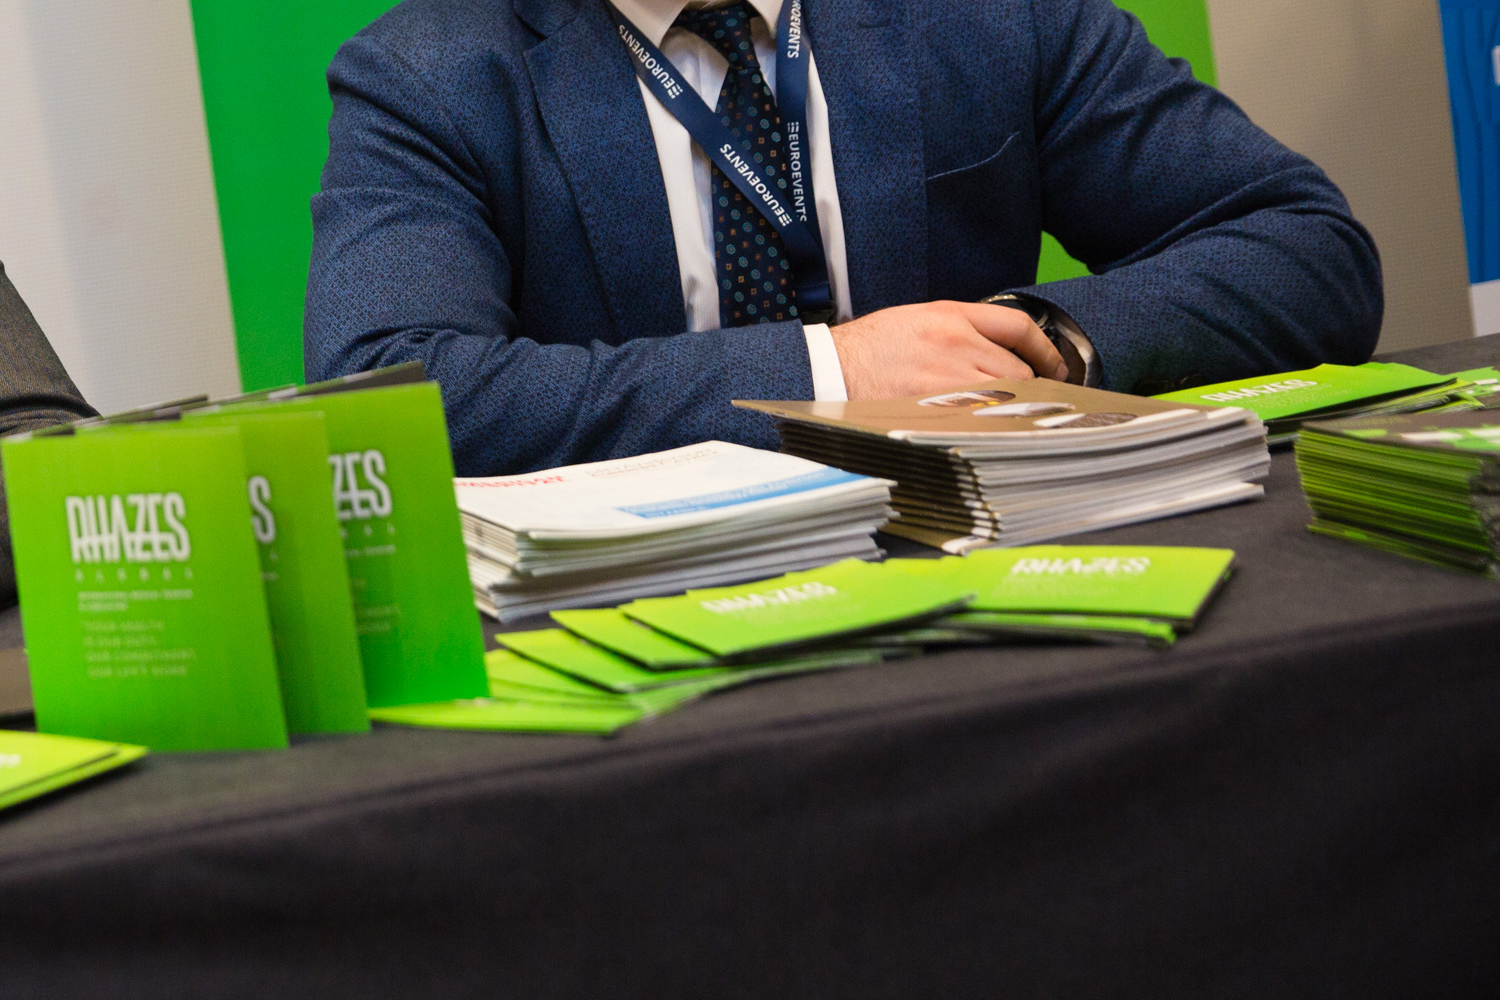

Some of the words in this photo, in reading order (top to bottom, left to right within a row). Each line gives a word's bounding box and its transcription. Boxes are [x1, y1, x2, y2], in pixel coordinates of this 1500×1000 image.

[619, 24, 676, 90] EUROEVENTS
[720, 143, 786, 219] EUROEVENTS
[789, 134, 807, 222] EUROEVENTS
[328, 449, 392, 520] ZES
[64, 486, 192, 564] RHAZES
